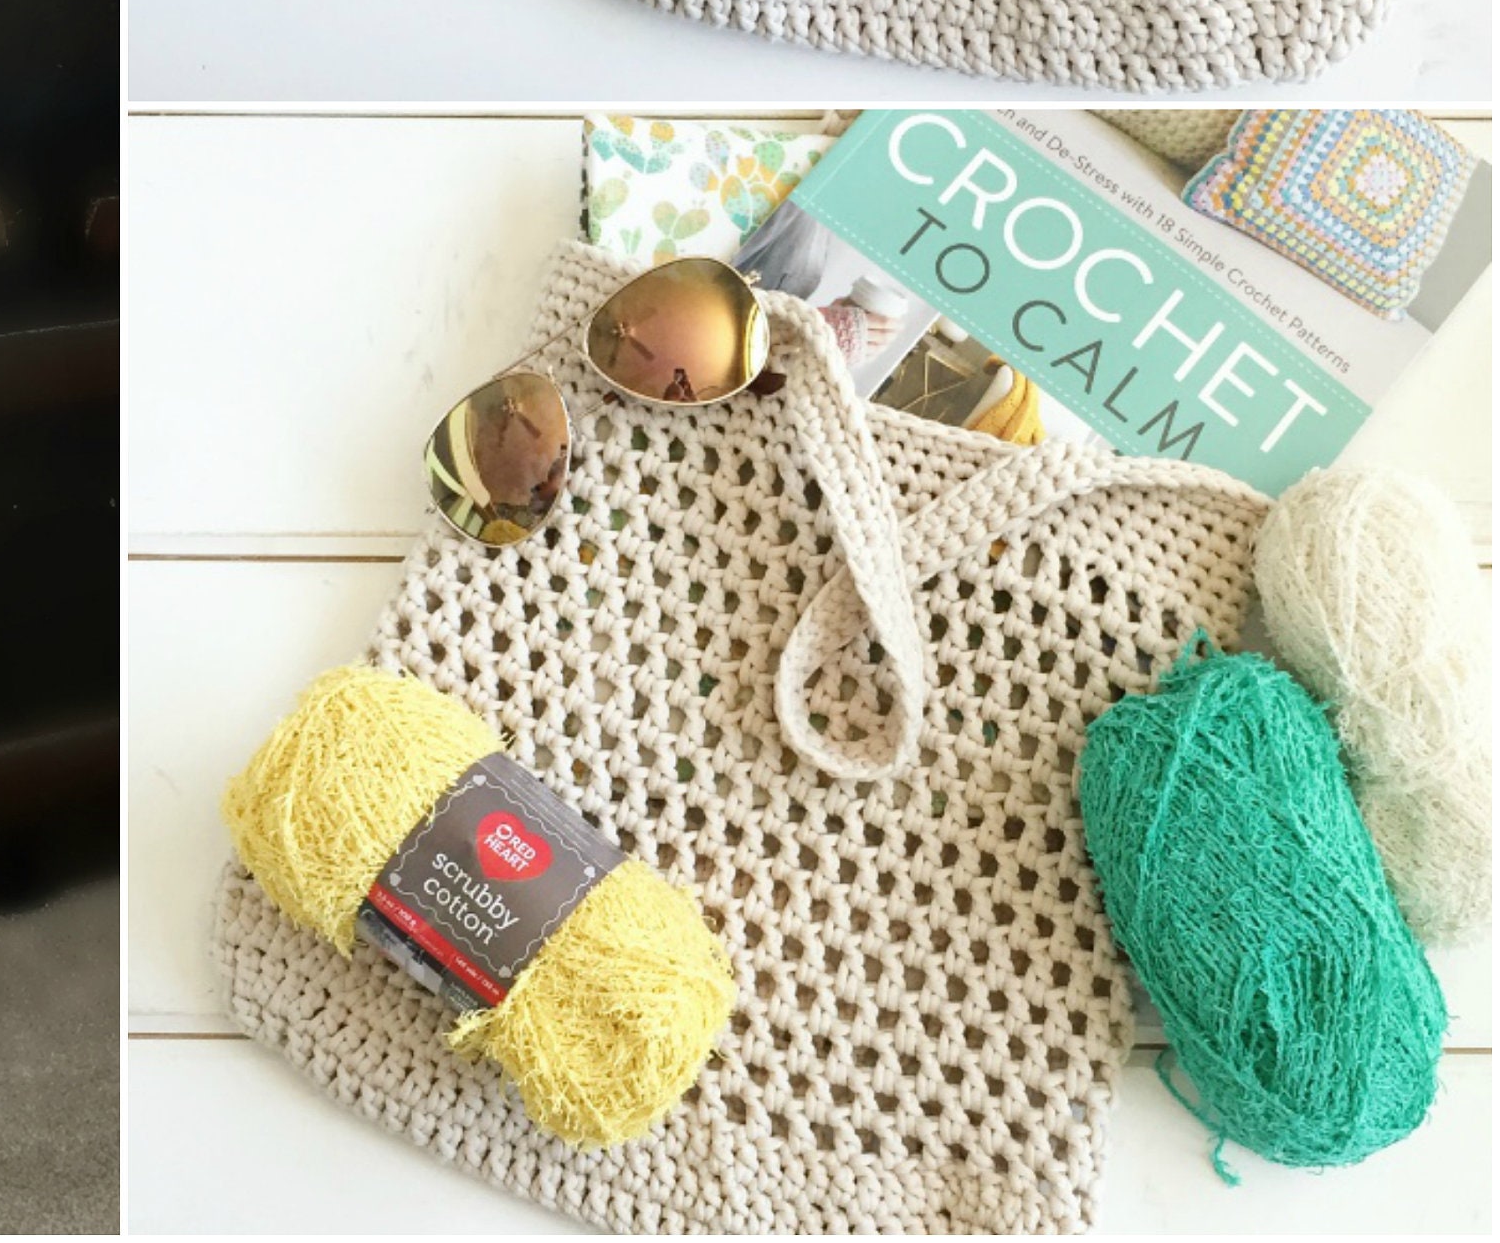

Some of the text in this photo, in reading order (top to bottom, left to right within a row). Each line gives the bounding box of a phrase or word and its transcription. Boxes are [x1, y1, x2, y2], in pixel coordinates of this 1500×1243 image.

[997, 109, 1351, 374] n and De-Stress with 18 Simple Crochet Patterns
[888, 113, 1328, 453] CROCHET
[899, 207, 1205, 461] TO CALM
[483, 834, 530, 872] HEART
[509, 835, 537, 861] RED
[423, 878, 494, 945] cotton
[431, 853, 520, 930] scrubby
